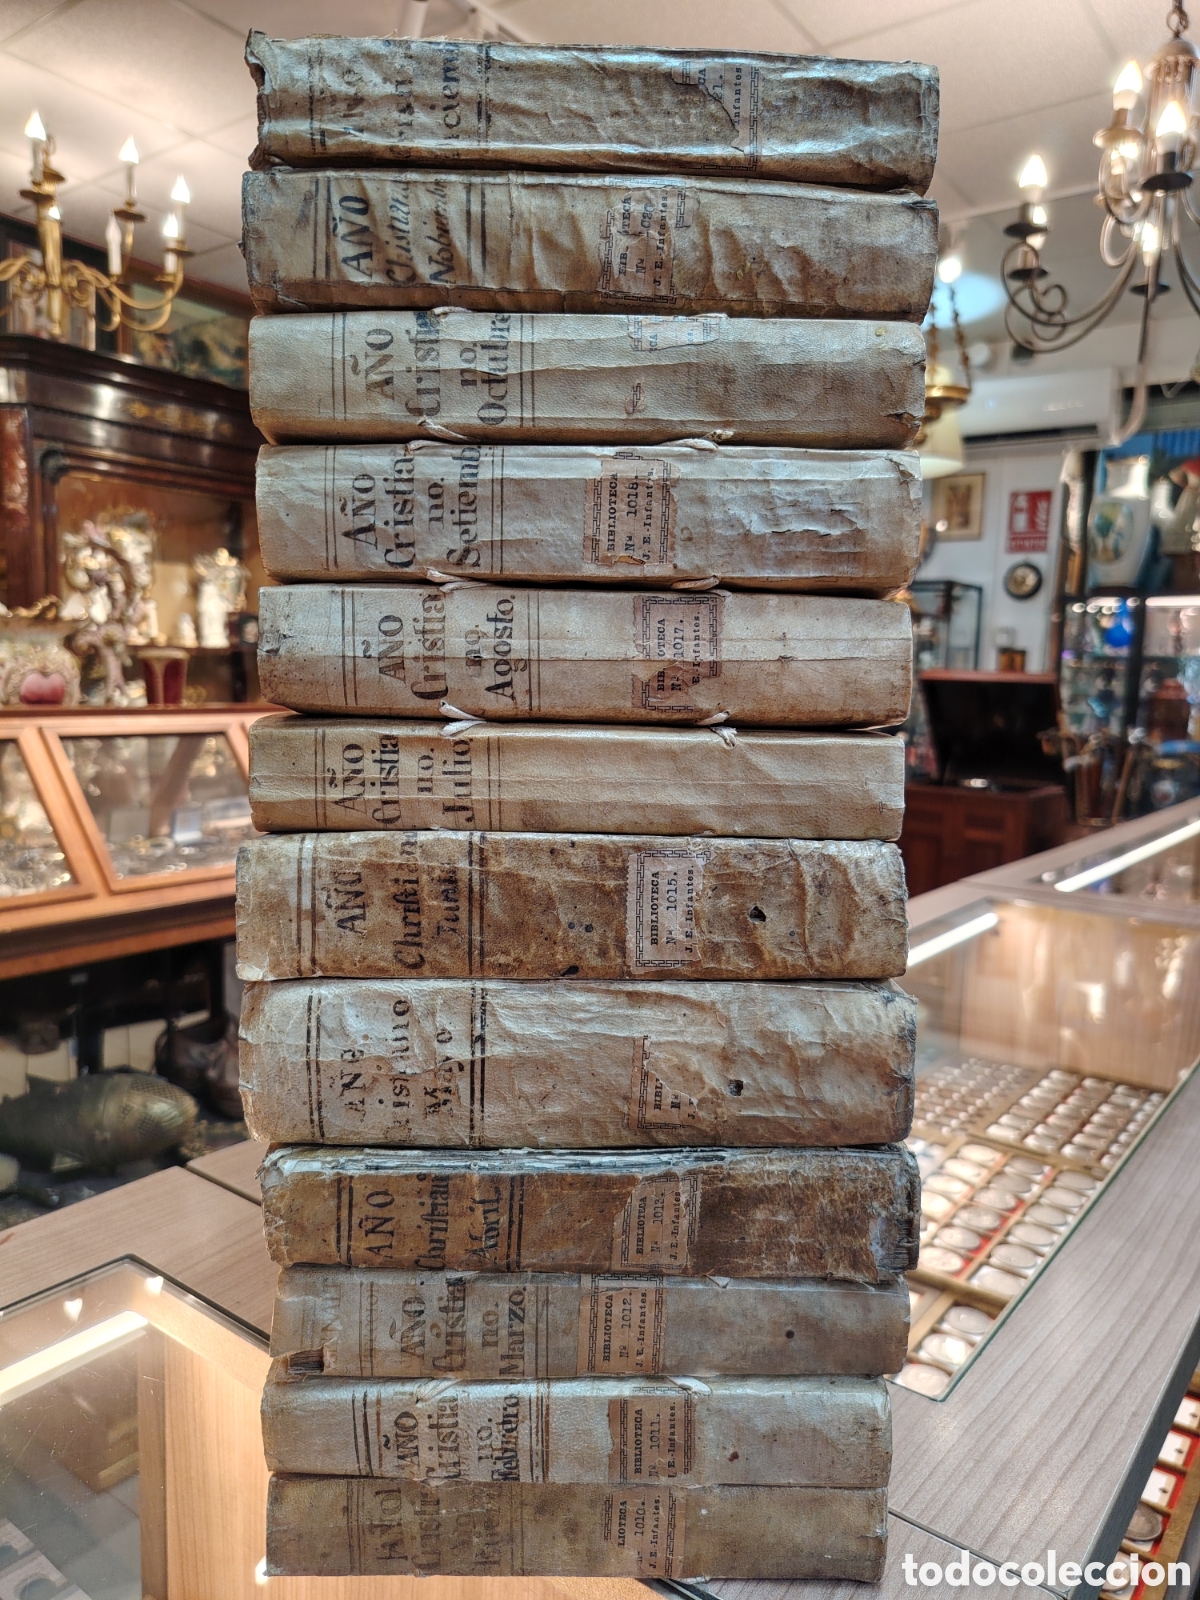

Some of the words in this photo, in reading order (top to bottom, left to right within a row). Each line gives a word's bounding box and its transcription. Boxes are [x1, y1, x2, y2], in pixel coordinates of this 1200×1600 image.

[332, 194, 373, 279] AÑO
[342, 327, 394, 400] AÑO
[458, 341, 478, 387] no.
[340, 472, 378, 550] AÑO
[427, 477, 445, 533] no.
[606, 473, 618, 552] BIBLIOTECA
[362, 615, 406, 684] AÑO
[411, 592, 449, 700] Cristia
[465, 624, 482, 677] no.
[485, 594, 527, 702] Agosto.
[329, 743, 368, 815] AÑO
[417, 747, 435, 794] no.
[651, 871, 660, 946] BIBLIOTECA
[358, 1188, 396, 1259] AÑO
[636, 1196, 647, 1255] BIBLIOTECA
[602, 1294, 614, 1363] BIBLIOTECA
[382, 1411, 420, 1467] AÑO
[634, 1407, 643, 1475] BIBLIOTECA
